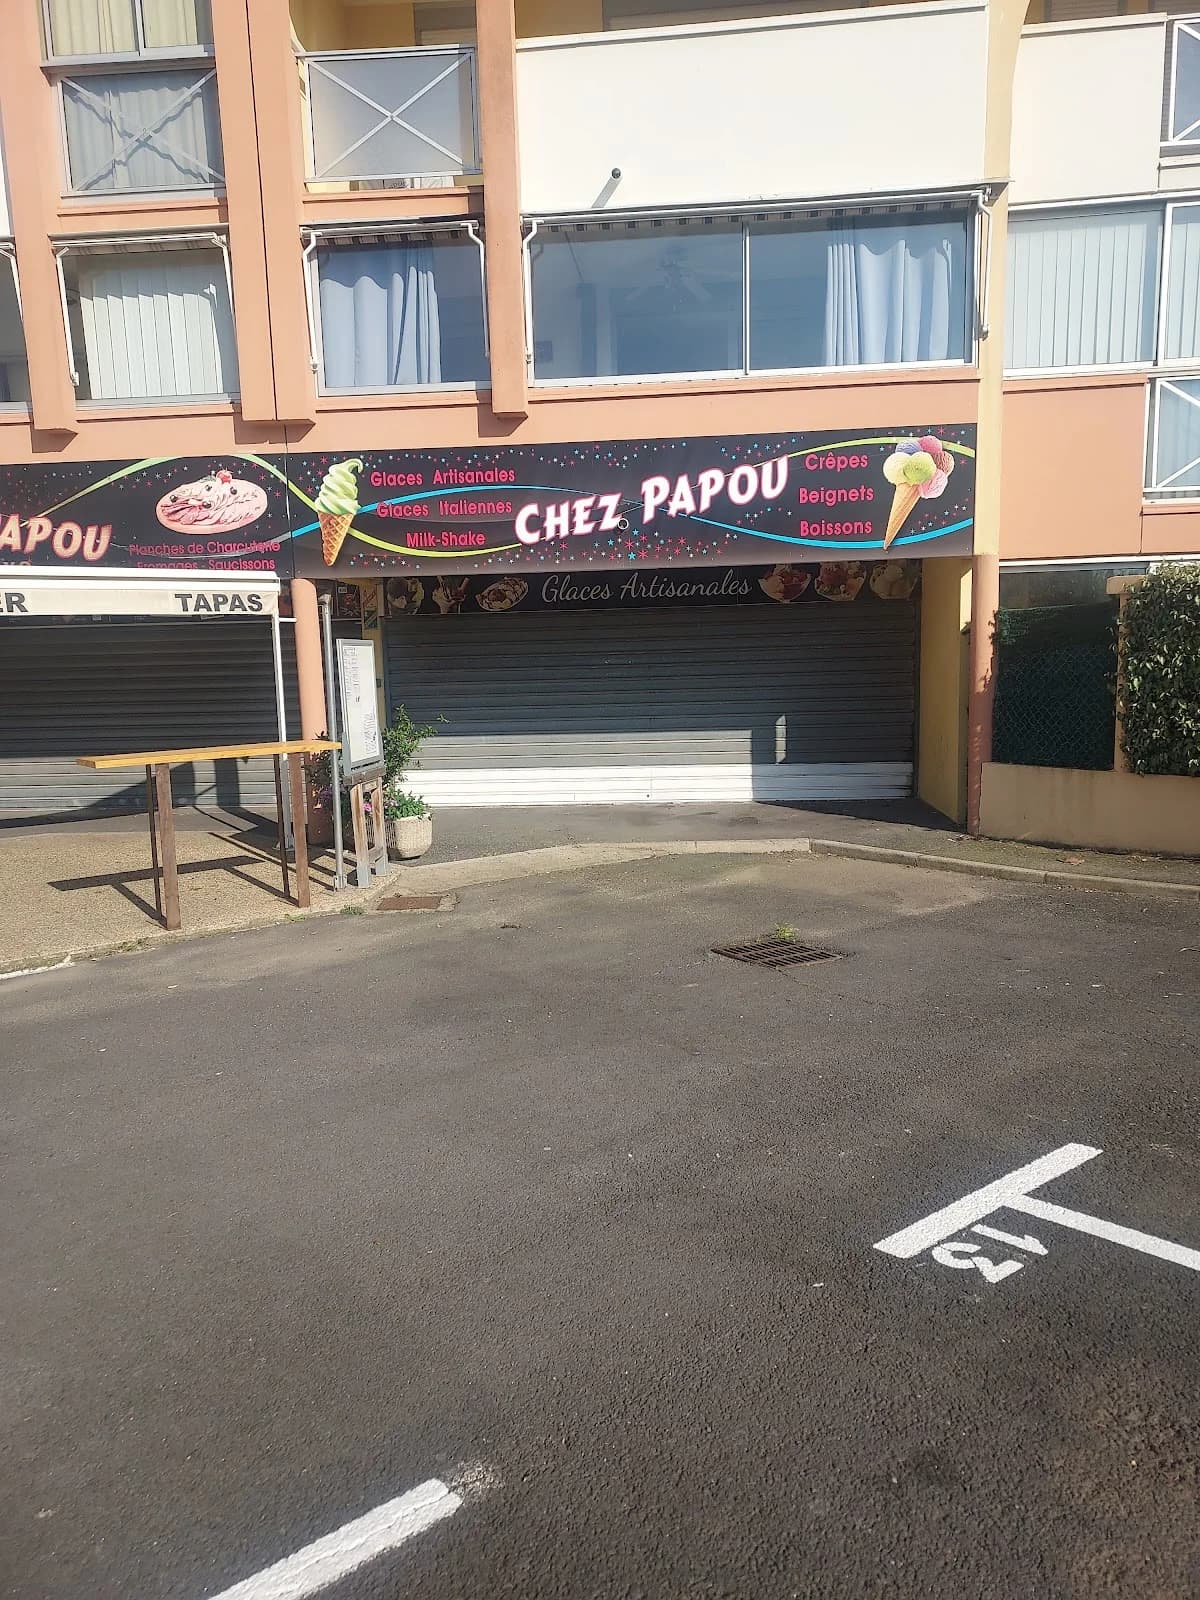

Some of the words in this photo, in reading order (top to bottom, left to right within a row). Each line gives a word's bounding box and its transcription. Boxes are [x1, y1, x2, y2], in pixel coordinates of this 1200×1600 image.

[805, 451, 868, 472] Crêpes
[370, 471, 423, 487] Glaces
[433, 468, 515, 485] Artisanales
[514, 492, 622, 544] CHEZ
[641, 454, 789, 524] PAPOU
[799, 484, 874, 507] Beignets
[376, 502, 429, 518] Glaces
[439, 500, 512, 516] Italiennes
[0, 513, 112, 561] APOU
[800, 519, 872, 537] Boissons
[129, 543, 185, 556] Planches
[187, 541, 204, 554] de
[206, 540, 280, 553] Charcuterie
[406, 531, 486, 547] Milk-Shake
[208, 558, 275, 570] Saucissons
[541, 574, 614, 603] Glaces
[619, 568, 753, 599] Artisanales
[175, 593, 263, 612] TAPAS
